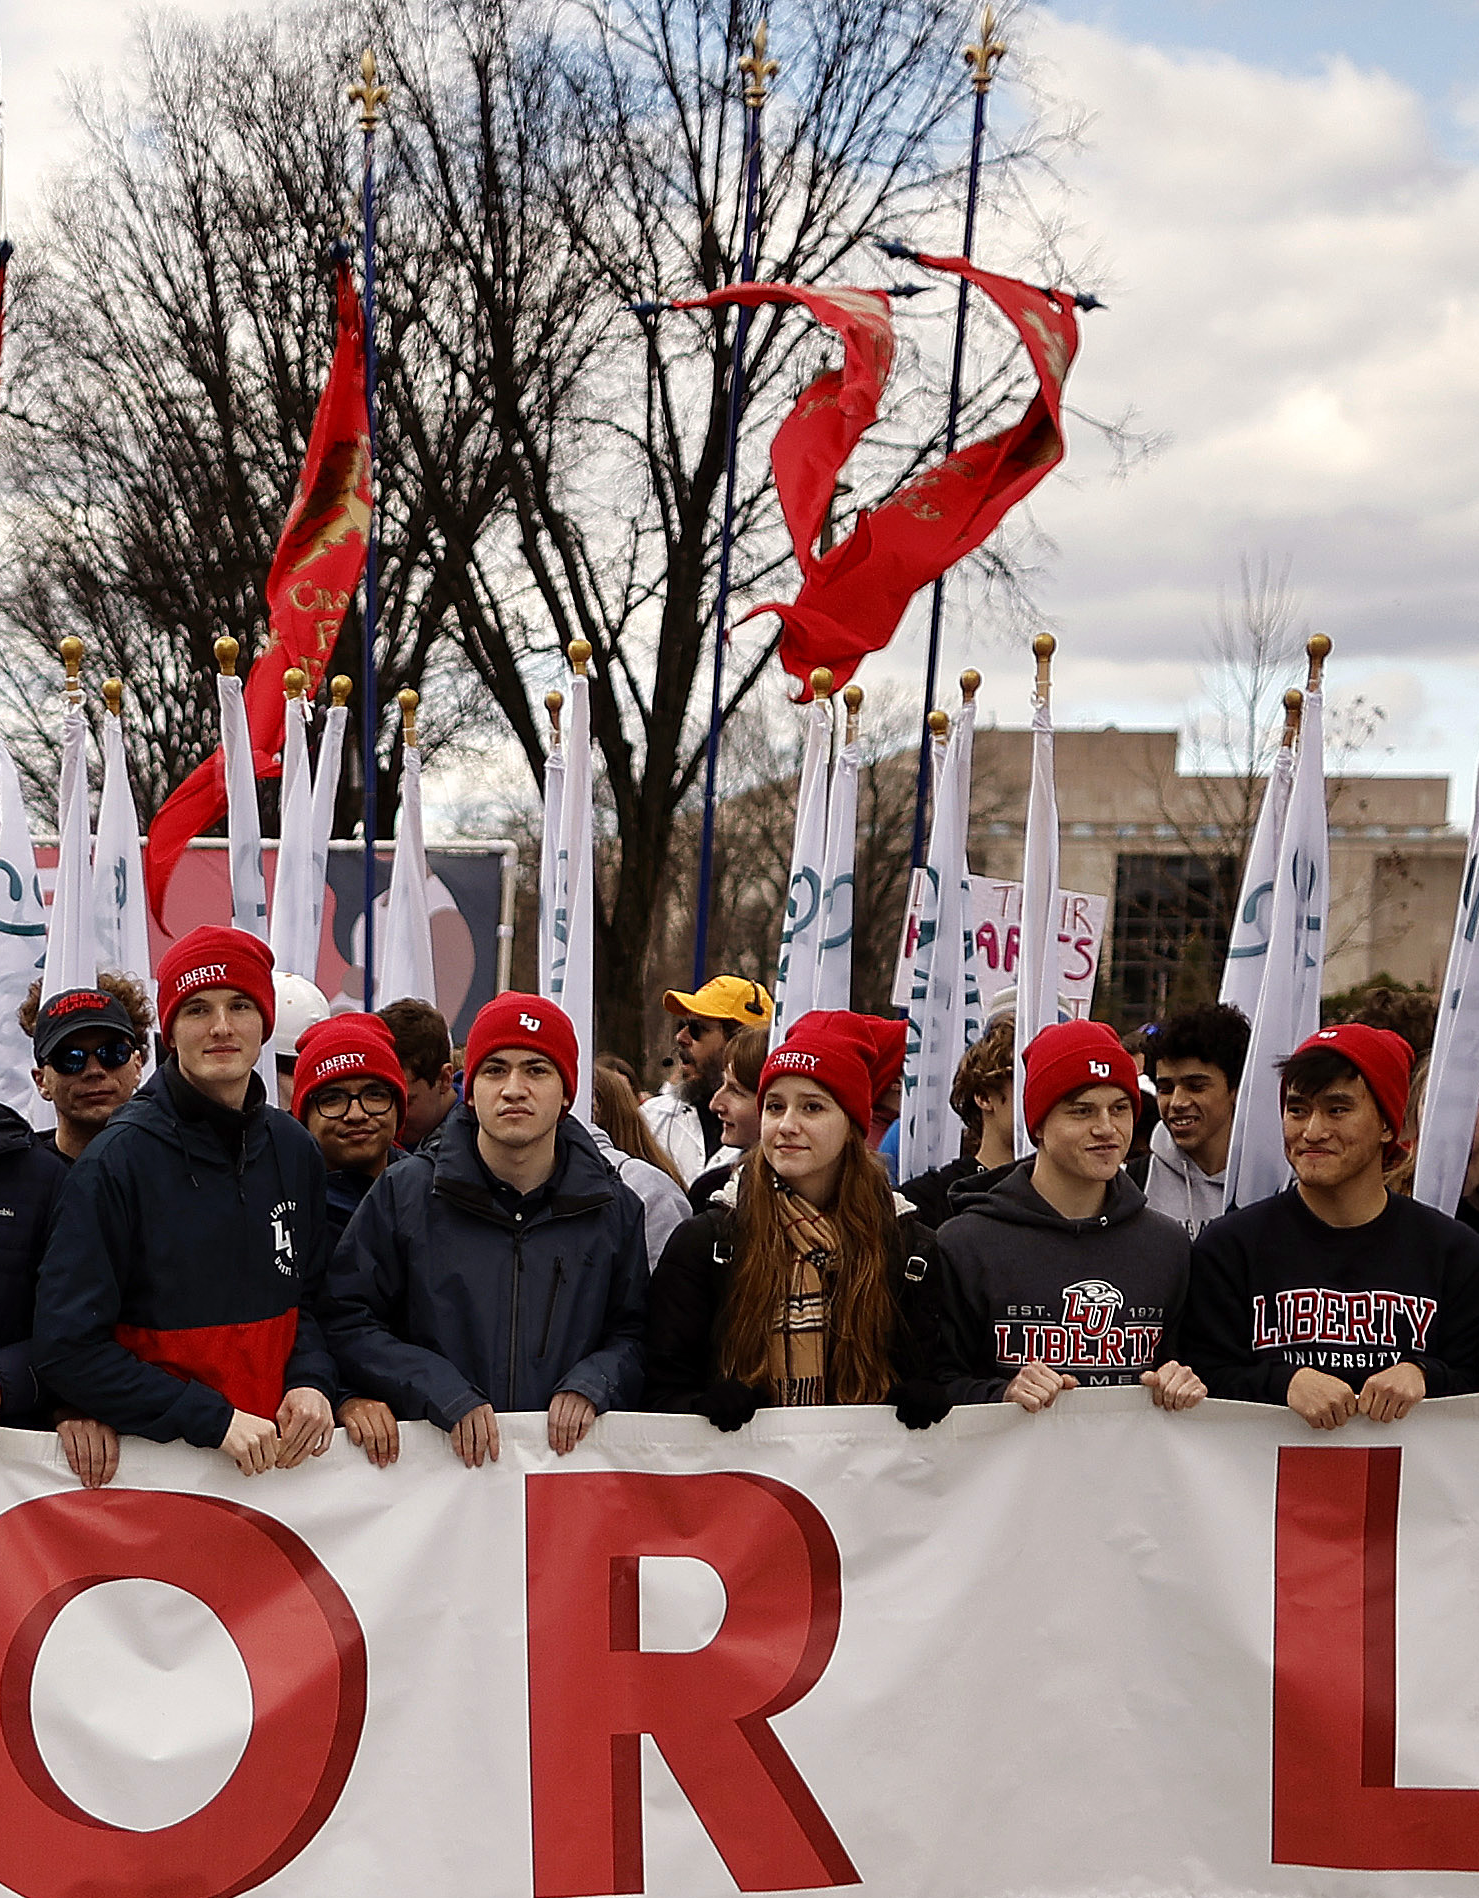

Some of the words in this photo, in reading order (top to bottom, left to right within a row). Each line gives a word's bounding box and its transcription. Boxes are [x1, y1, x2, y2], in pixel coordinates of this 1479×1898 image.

[991, 884, 1093, 935] TIR
[176, 964, 227, 992] LIBERTY
[518, 1013, 541, 1032] LU
[314, 1053, 366, 1077] LIBERTY
[1089, 1060, 1110, 1078] LU
[1007, 1303, 1052, 1318] EST.
[1128, 1305, 1164, 1318] 1971
[1063, 1288, 1113, 1337] LU
[1251, 1286, 1438, 1352] LIBERTY
[995, 1324, 1163, 1367] LIBERTY
[1283, 1349, 1403, 1369] UNIVERSITY
